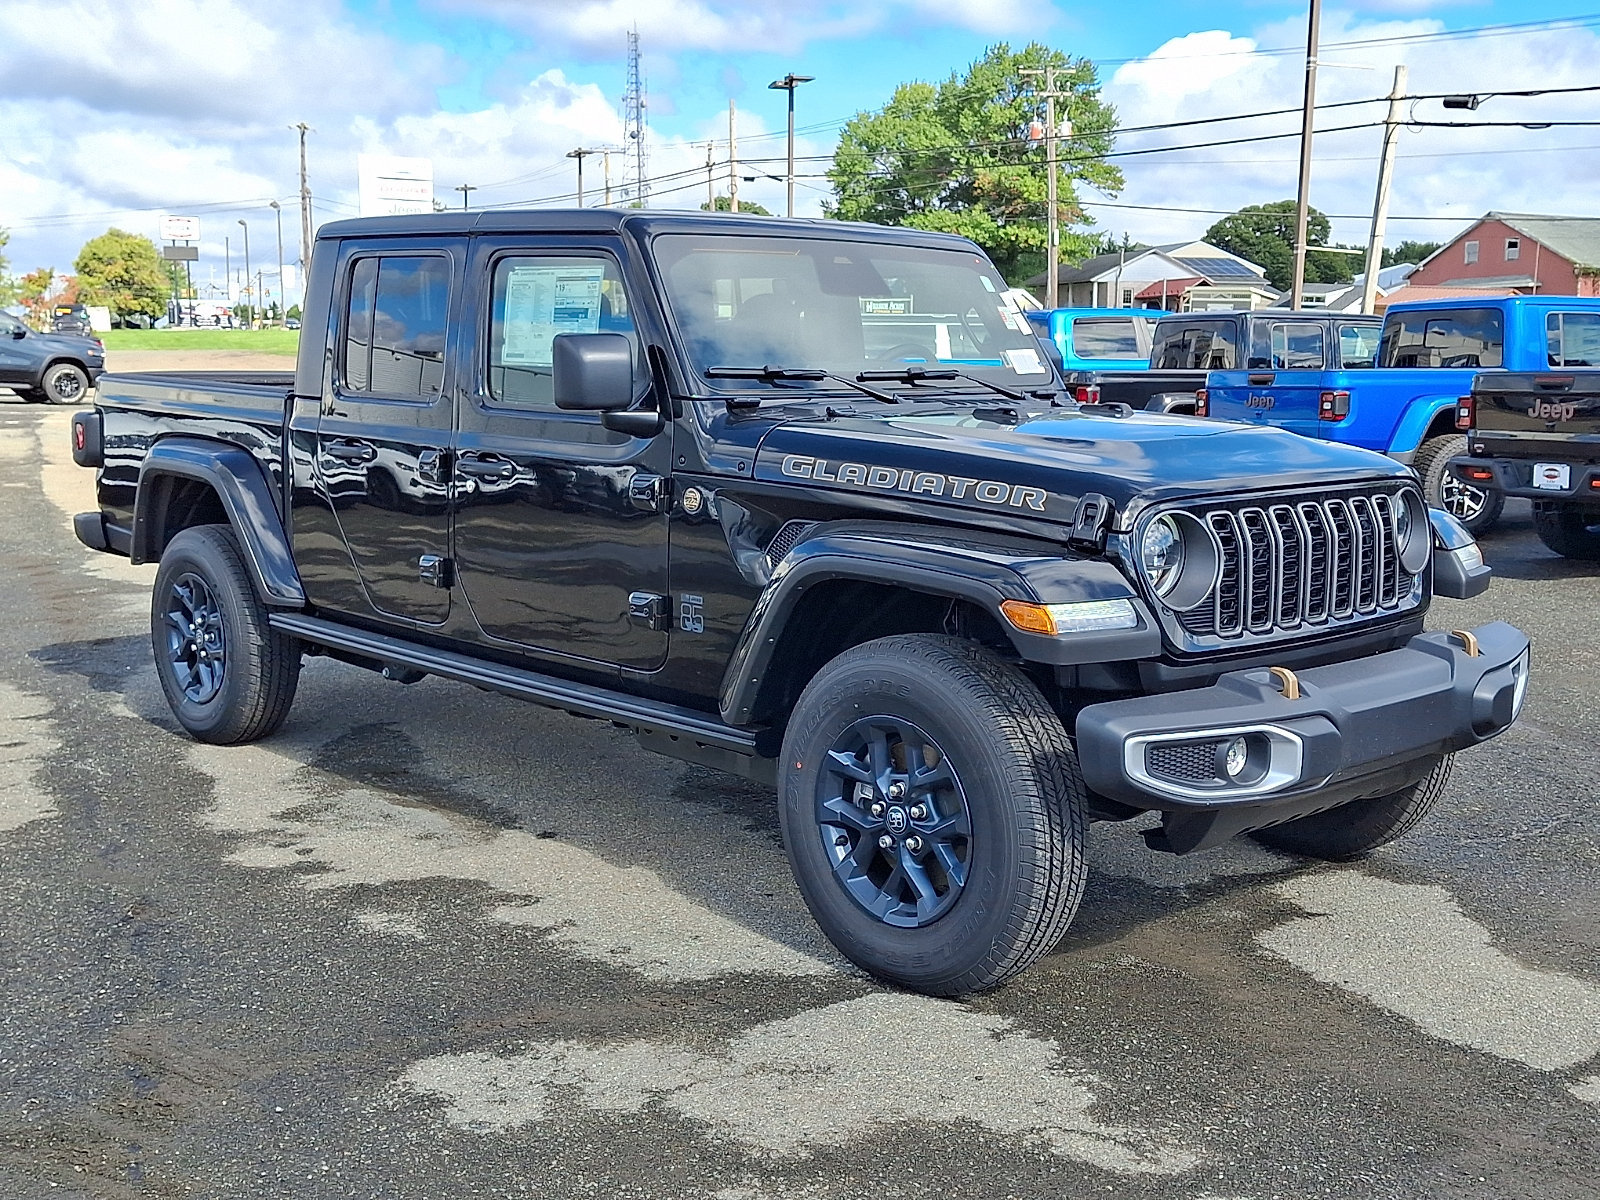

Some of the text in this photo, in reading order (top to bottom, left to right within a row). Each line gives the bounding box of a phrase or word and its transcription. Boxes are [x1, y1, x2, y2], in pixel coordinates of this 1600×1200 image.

[1244, 392, 1275, 411] Jeep
[1527, 398, 1575, 422] Jeep
[781, 454, 1048, 512] GLADIATOR
